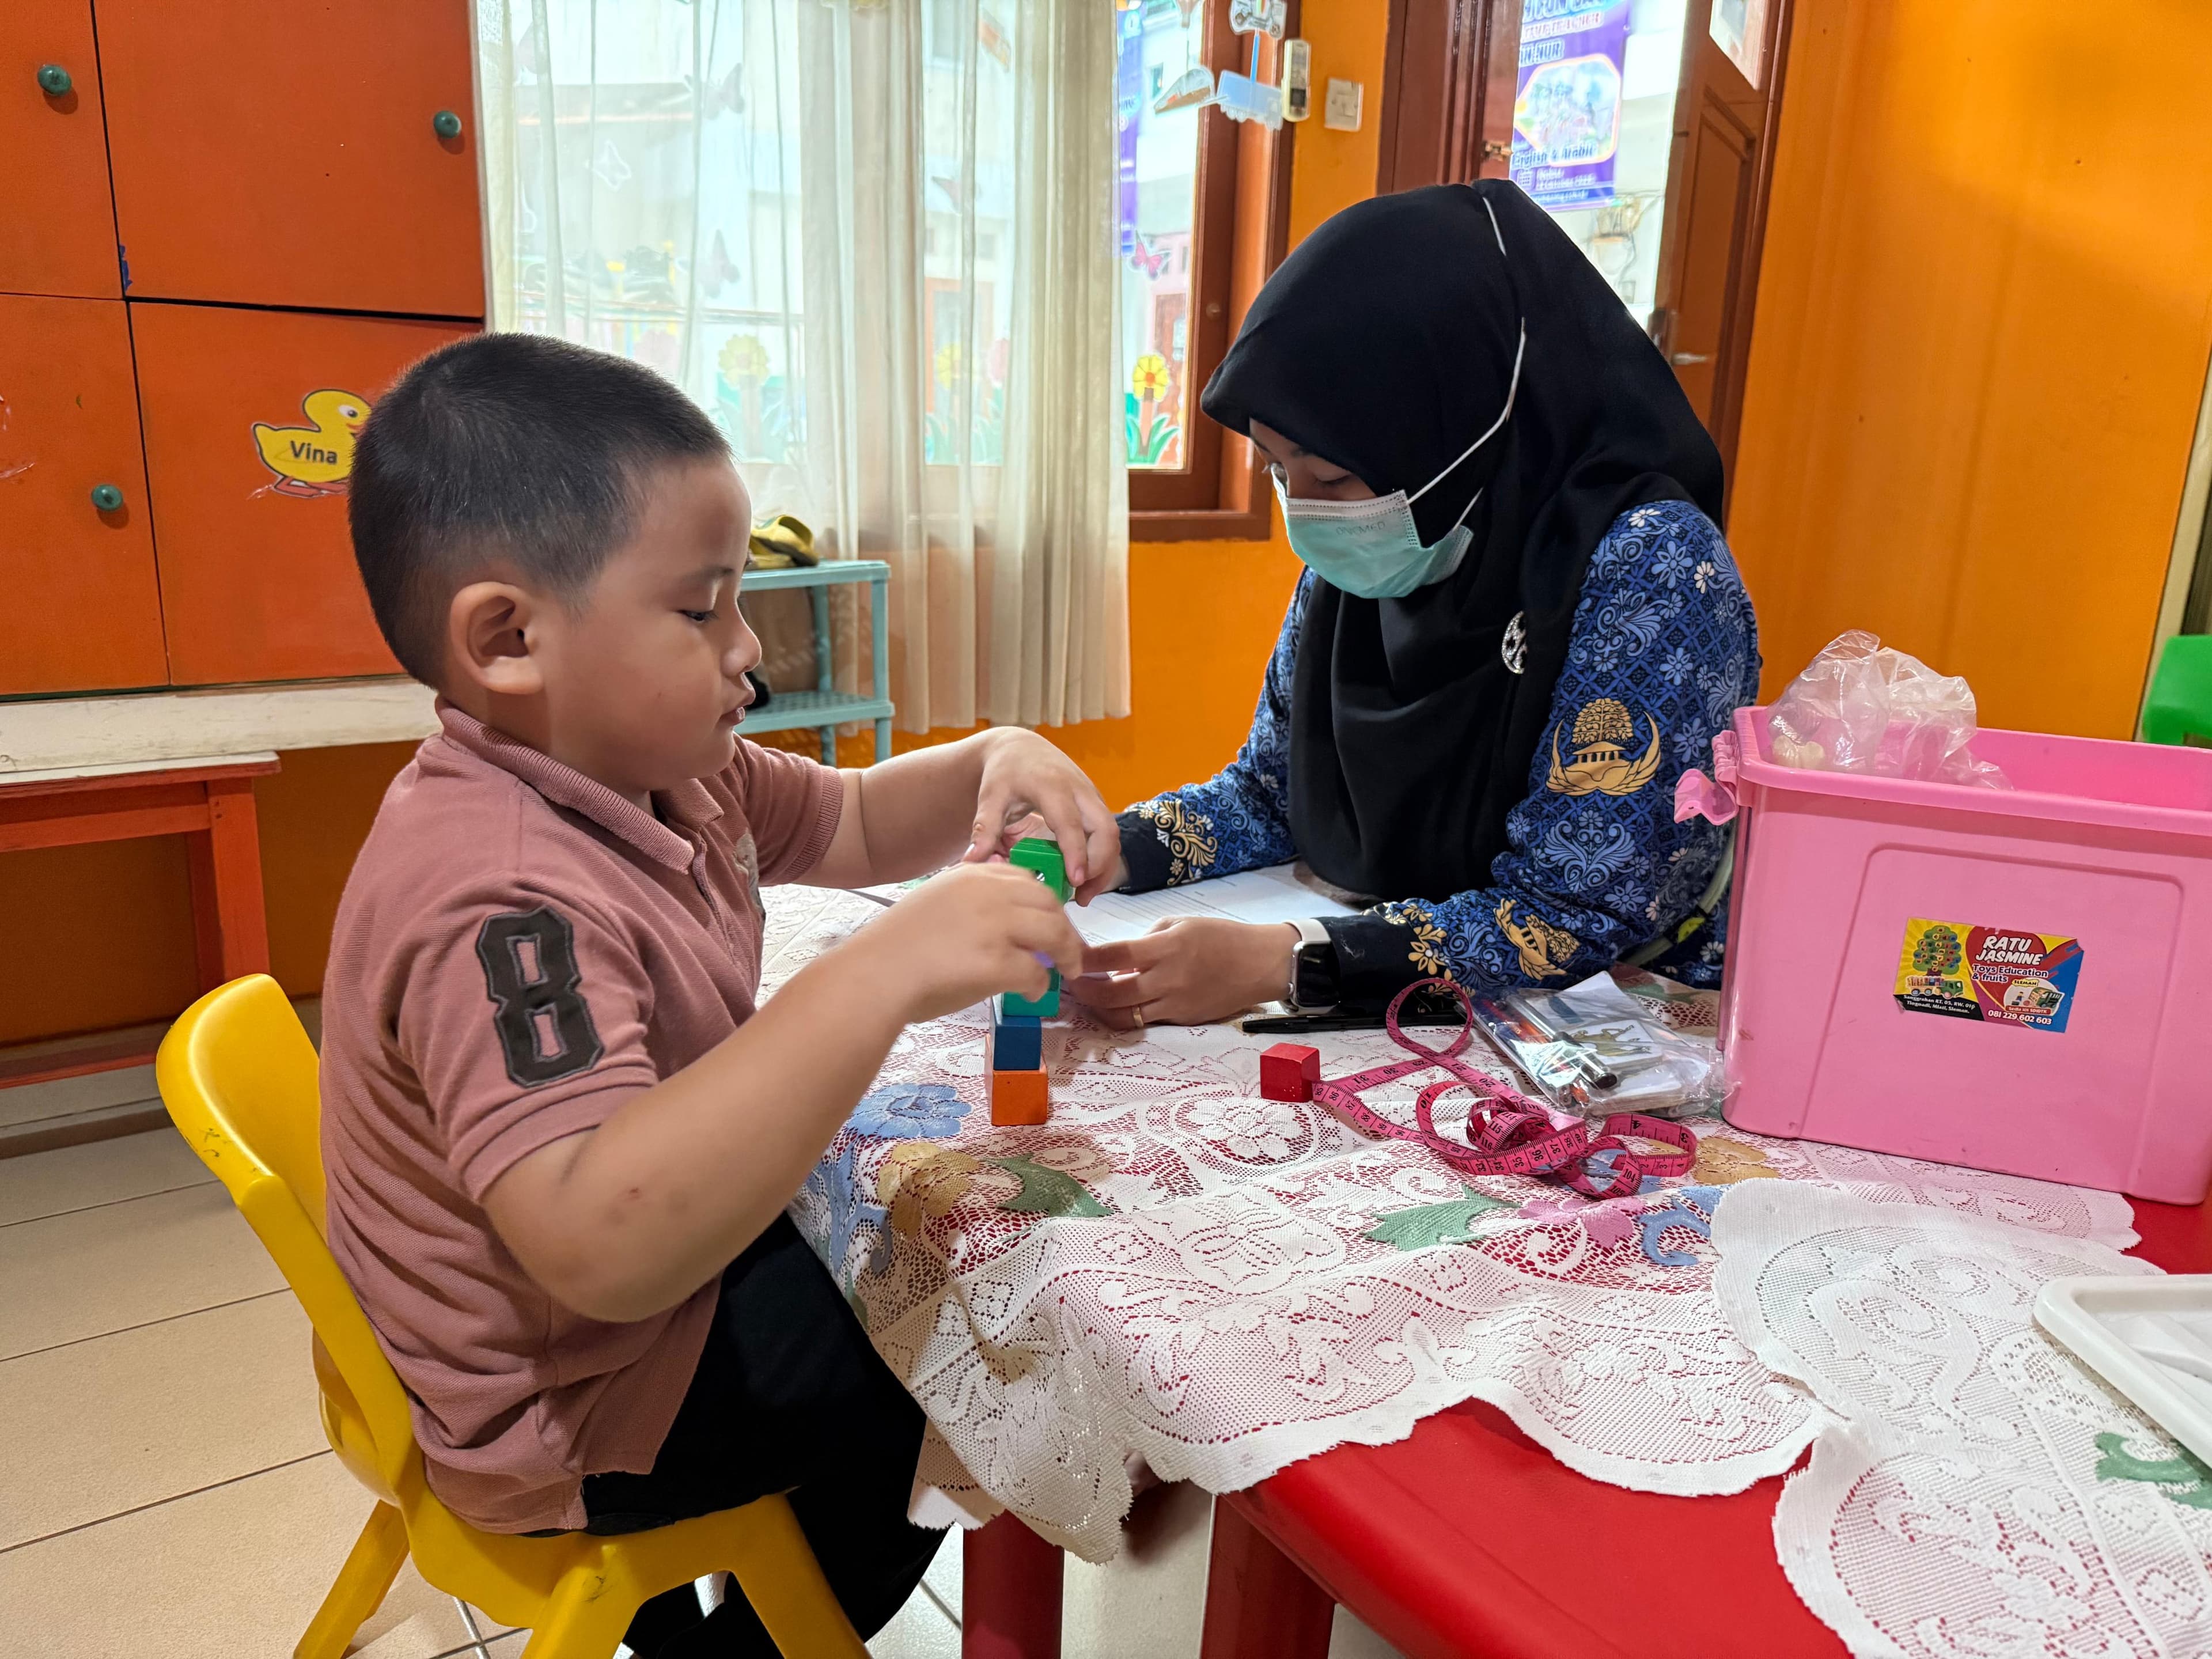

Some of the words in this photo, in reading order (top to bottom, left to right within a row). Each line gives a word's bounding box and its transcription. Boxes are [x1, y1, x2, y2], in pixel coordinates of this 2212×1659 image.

[290, 440, 338, 464] Vina
[1983, 935, 2032, 952] RATU
[1975, 949, 2043, 965] JASMINE
[1972, 964, 1996, 973] Toys
[1999, 967, 2047, 977] Education
[1982, 974, 2008, 982] fruits
[475, 905, 606, 1089] 8
[1988, 1010, 2002, 1018] 081
[2002, 1012, 2017, 1020] 229
[2019, 1014, 2035, 1022] 602
[1351, 1074, 1370, 1085] 31
[1328, 1091, 1340, 1101] 86
[1487, 1120, 1503, 1134] 115
[1480, 1137, 1493, 1151] 116
[1680, 1132, 1690, 1144] 3
[1532, 1149, 1544, 1162] 36
[1550, 1143, 1561, 1156] 37
[1512, 1156, 1524, 1169] 35
[1659, 1161, 1668, 1169] 3
[1623, 1168, 1637, 1182] 104
[1610, 1185, 1625, 1196] 105
